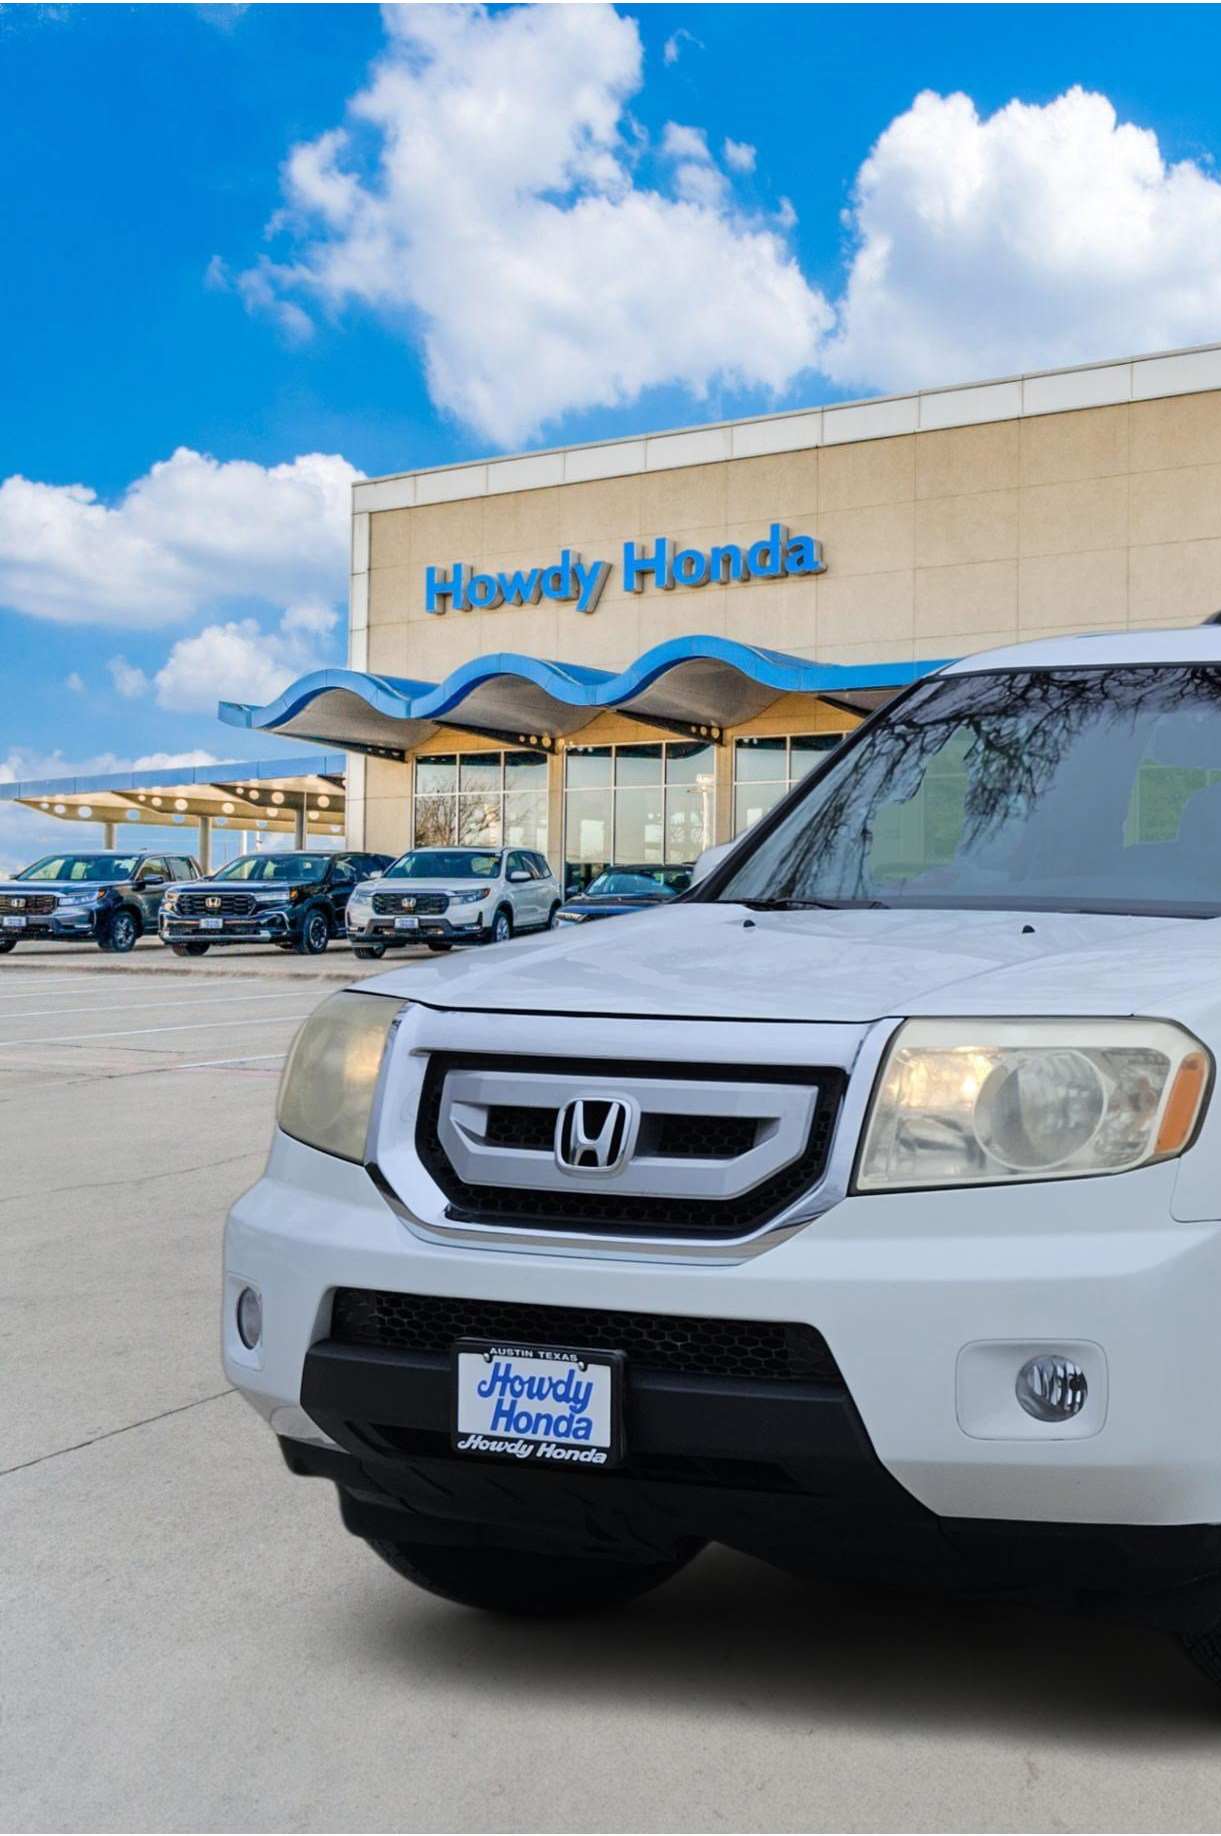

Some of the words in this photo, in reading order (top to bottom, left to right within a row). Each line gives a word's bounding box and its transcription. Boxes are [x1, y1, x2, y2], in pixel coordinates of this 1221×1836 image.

[425, 549, 612, 614] Howdy
[623, 522, 828, 594] Honda
[490, 1347, 533, 1358] AUSTIN
[538, 1350, 578, 1362] TEXAS
[477, 1362, 593, 1414] Howdy
[490, 1398, 593, 1440] Honda
[457, 1434, 534, 1459] Howdy
[536, 1443, 607, 1464] Honda
